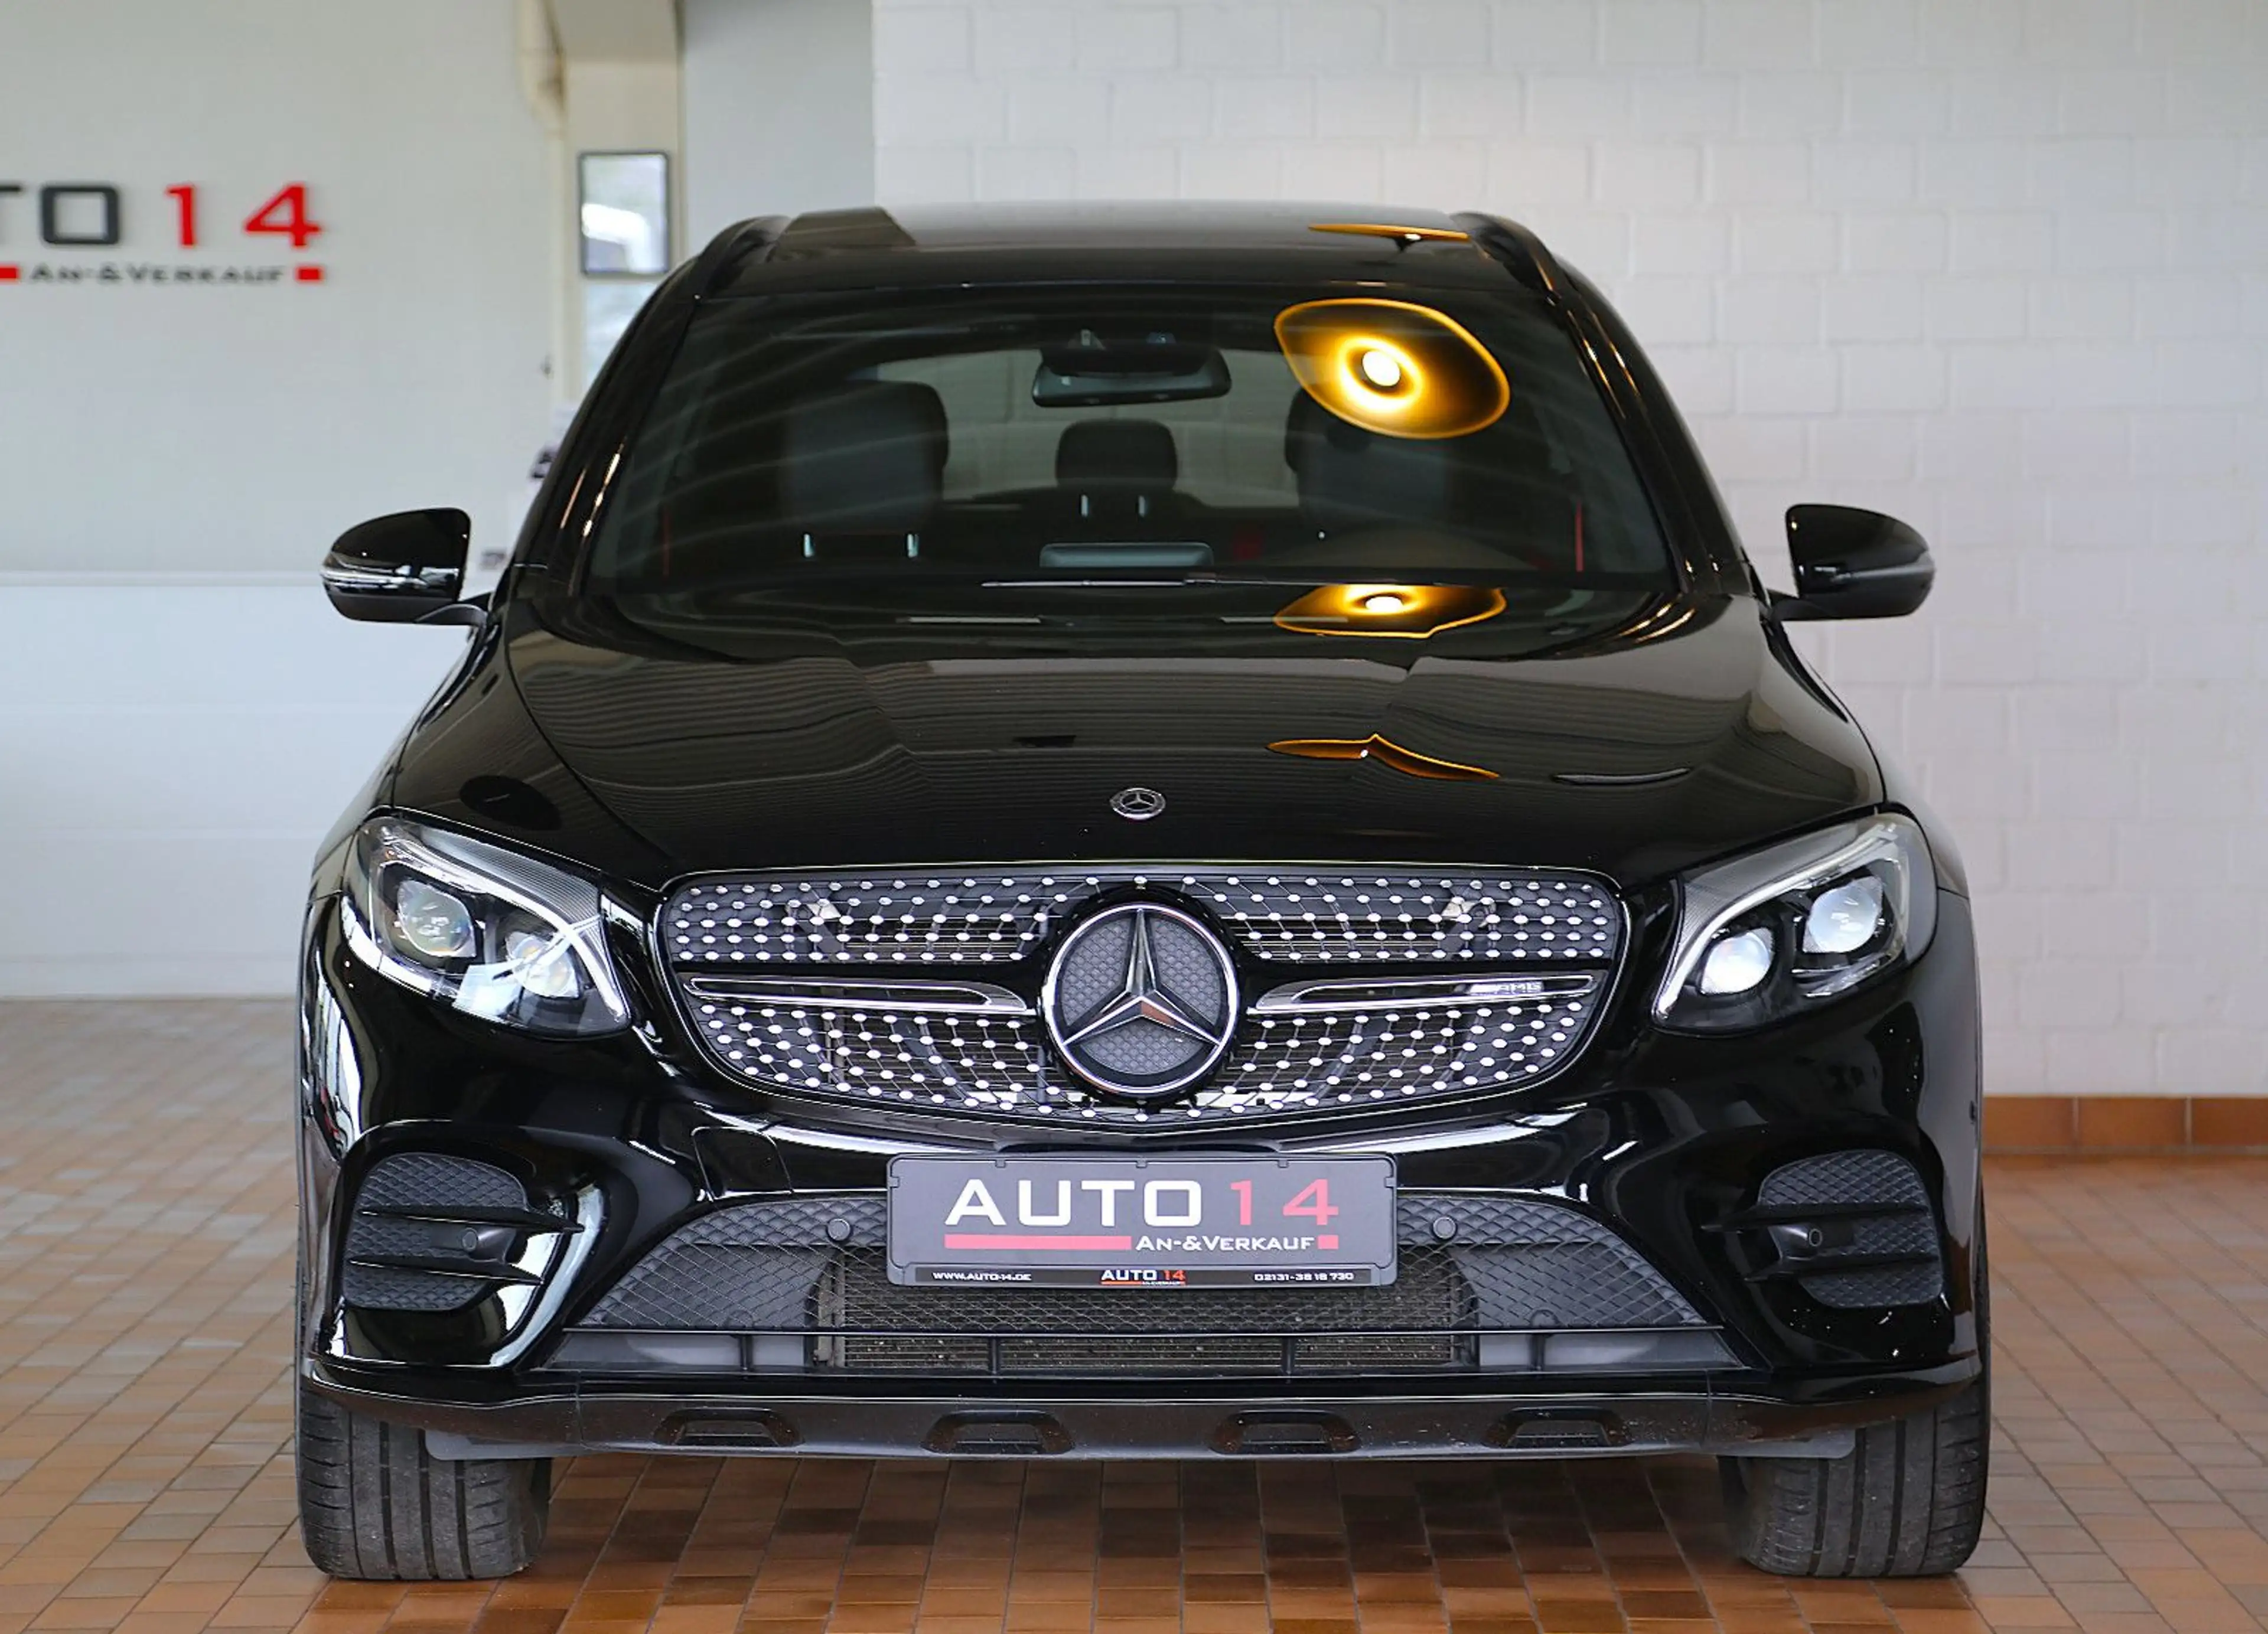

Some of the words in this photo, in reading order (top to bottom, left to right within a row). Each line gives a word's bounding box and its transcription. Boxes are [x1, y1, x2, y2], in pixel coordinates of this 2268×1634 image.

[945, 1179, 1203, 1228] AUTO
[1230, 1179, 1339, 1227] 14
[1101, 1269, 1158, 1281] AUTO
[1164, 1269, 1186, 1281] 14
[1329, 1272, 1354, 1281] 730
